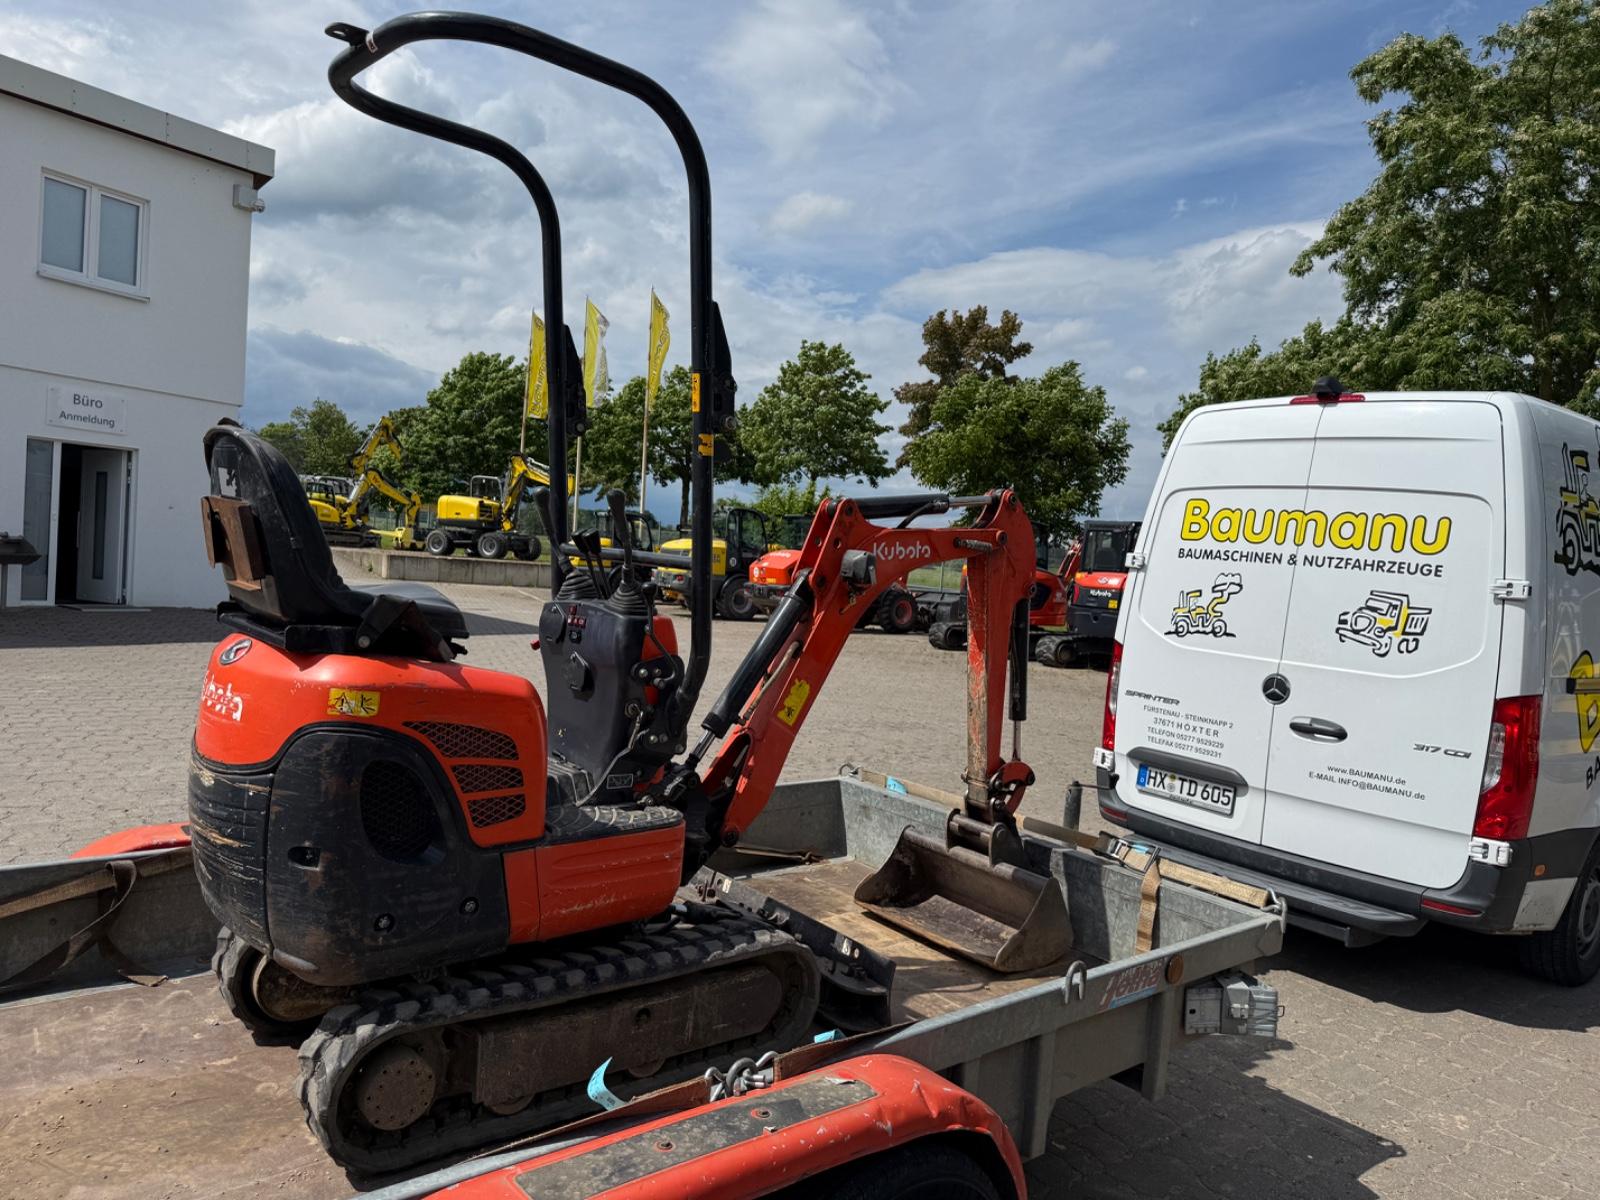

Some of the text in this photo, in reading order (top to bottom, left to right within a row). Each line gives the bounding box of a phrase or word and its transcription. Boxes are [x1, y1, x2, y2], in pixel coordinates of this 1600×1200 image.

[73, 393, 103, 409] Büro
[59, 410, 115, 429] Anmeldung
[1180, 498, 1452, 556] Baumanu
[873, 540, 931, 560] Kubota
[1178, 548, 1444, 578] BAUMASCHINEN & NUTZFAHRZEUGE
[1125, 690, 1180, 706] SPRINTER
[1153, 717, 1175, 728] 37671
[1184, 712, 1228, 728] STEINKNAPP
[1147, 726, 1175, 739] TELEFON
[1176, 733, 1195, 743] 05277
[1147, 735, 1174, 748] TELEFAX
[1175, 741, 1193, 752] 05277
[1413, 743, 1472, 759] 317 CDI
[1327, 765, 1406, 786] www.BAUMANU.de
[1147, 769, 1167, 790] HX
[1178, 777, 1198, 797] TD
[1200, 784, 1233, 806] 605
[1308, 771, 1426, 801] E-MAIL INFO@BAUMANU.de
